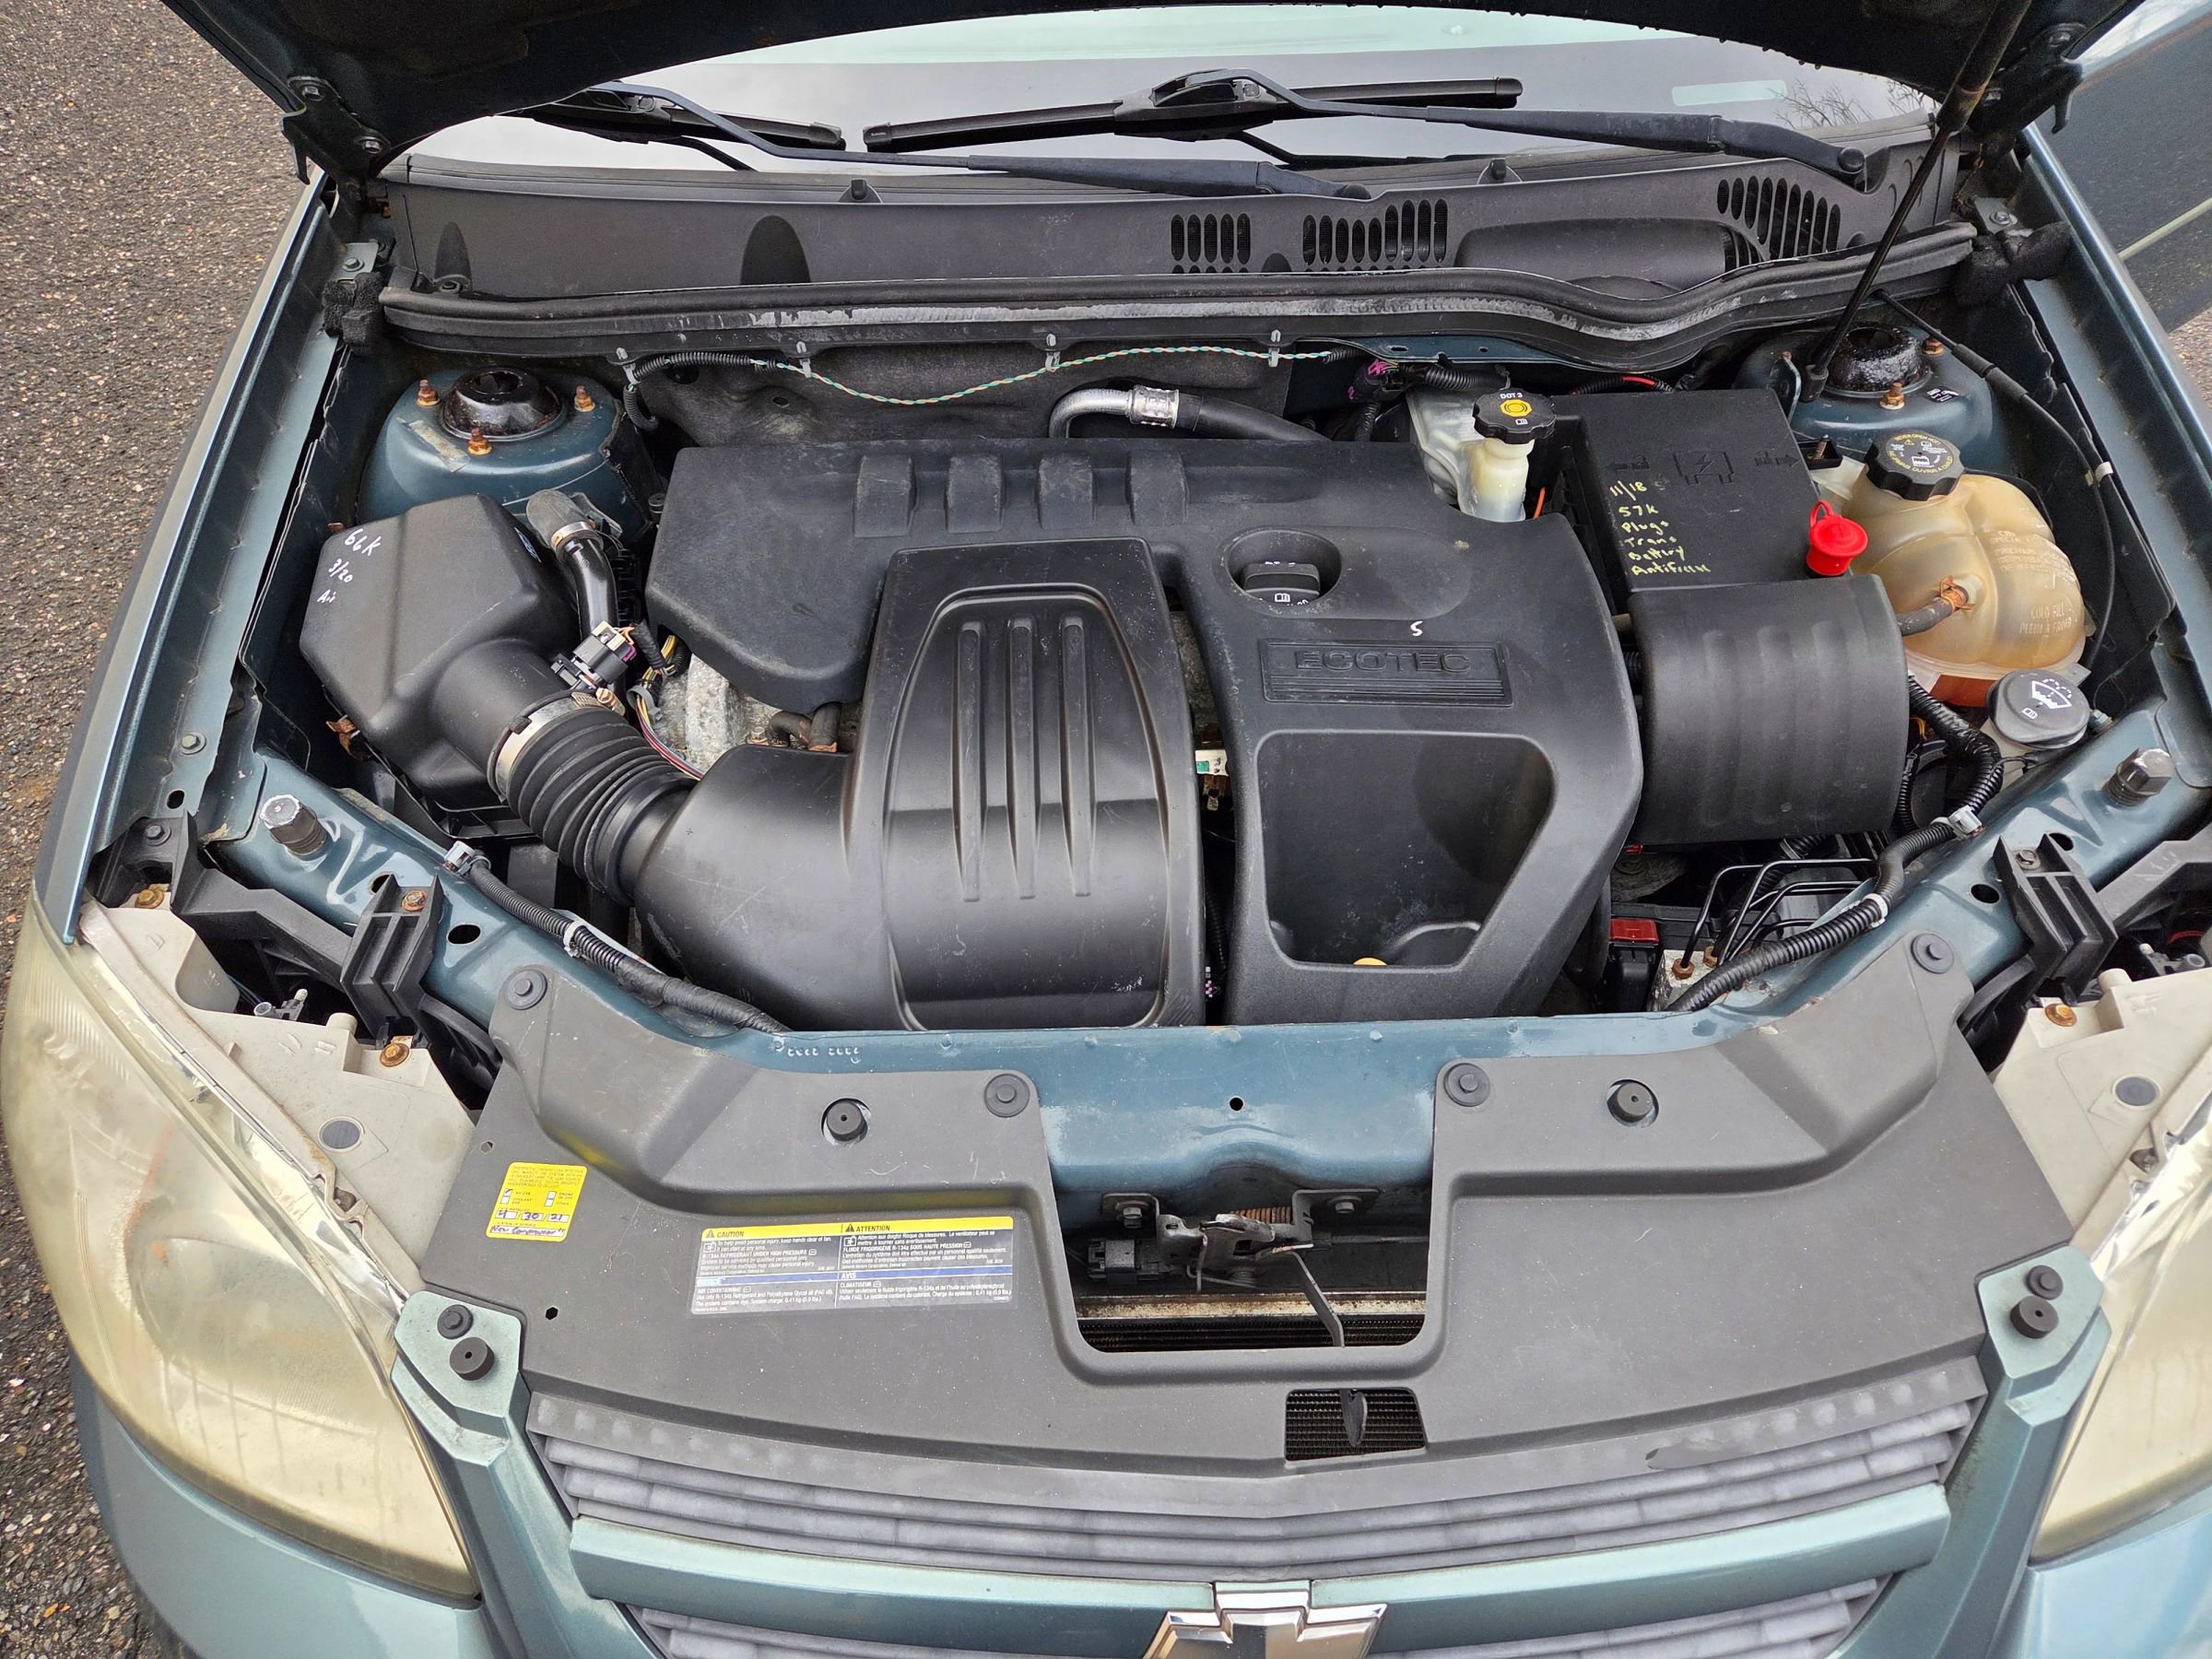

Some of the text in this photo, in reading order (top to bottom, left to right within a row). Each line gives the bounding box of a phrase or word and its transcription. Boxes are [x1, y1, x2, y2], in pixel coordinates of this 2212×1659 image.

[1609, 480, 1647, 501] 11/18
[1621, 520, 1669, 535] Plugs
[1624, 535, 1677, 547] Trans
[328, 558, 353, 583] 3/20
[1410, 620, 1423, 636] S
[1295, 650, 1472, 673] ECOTEC
[498, 1209, 563, 1221] 4 30 21
[841, 1271, 856, 1279] AVIS
